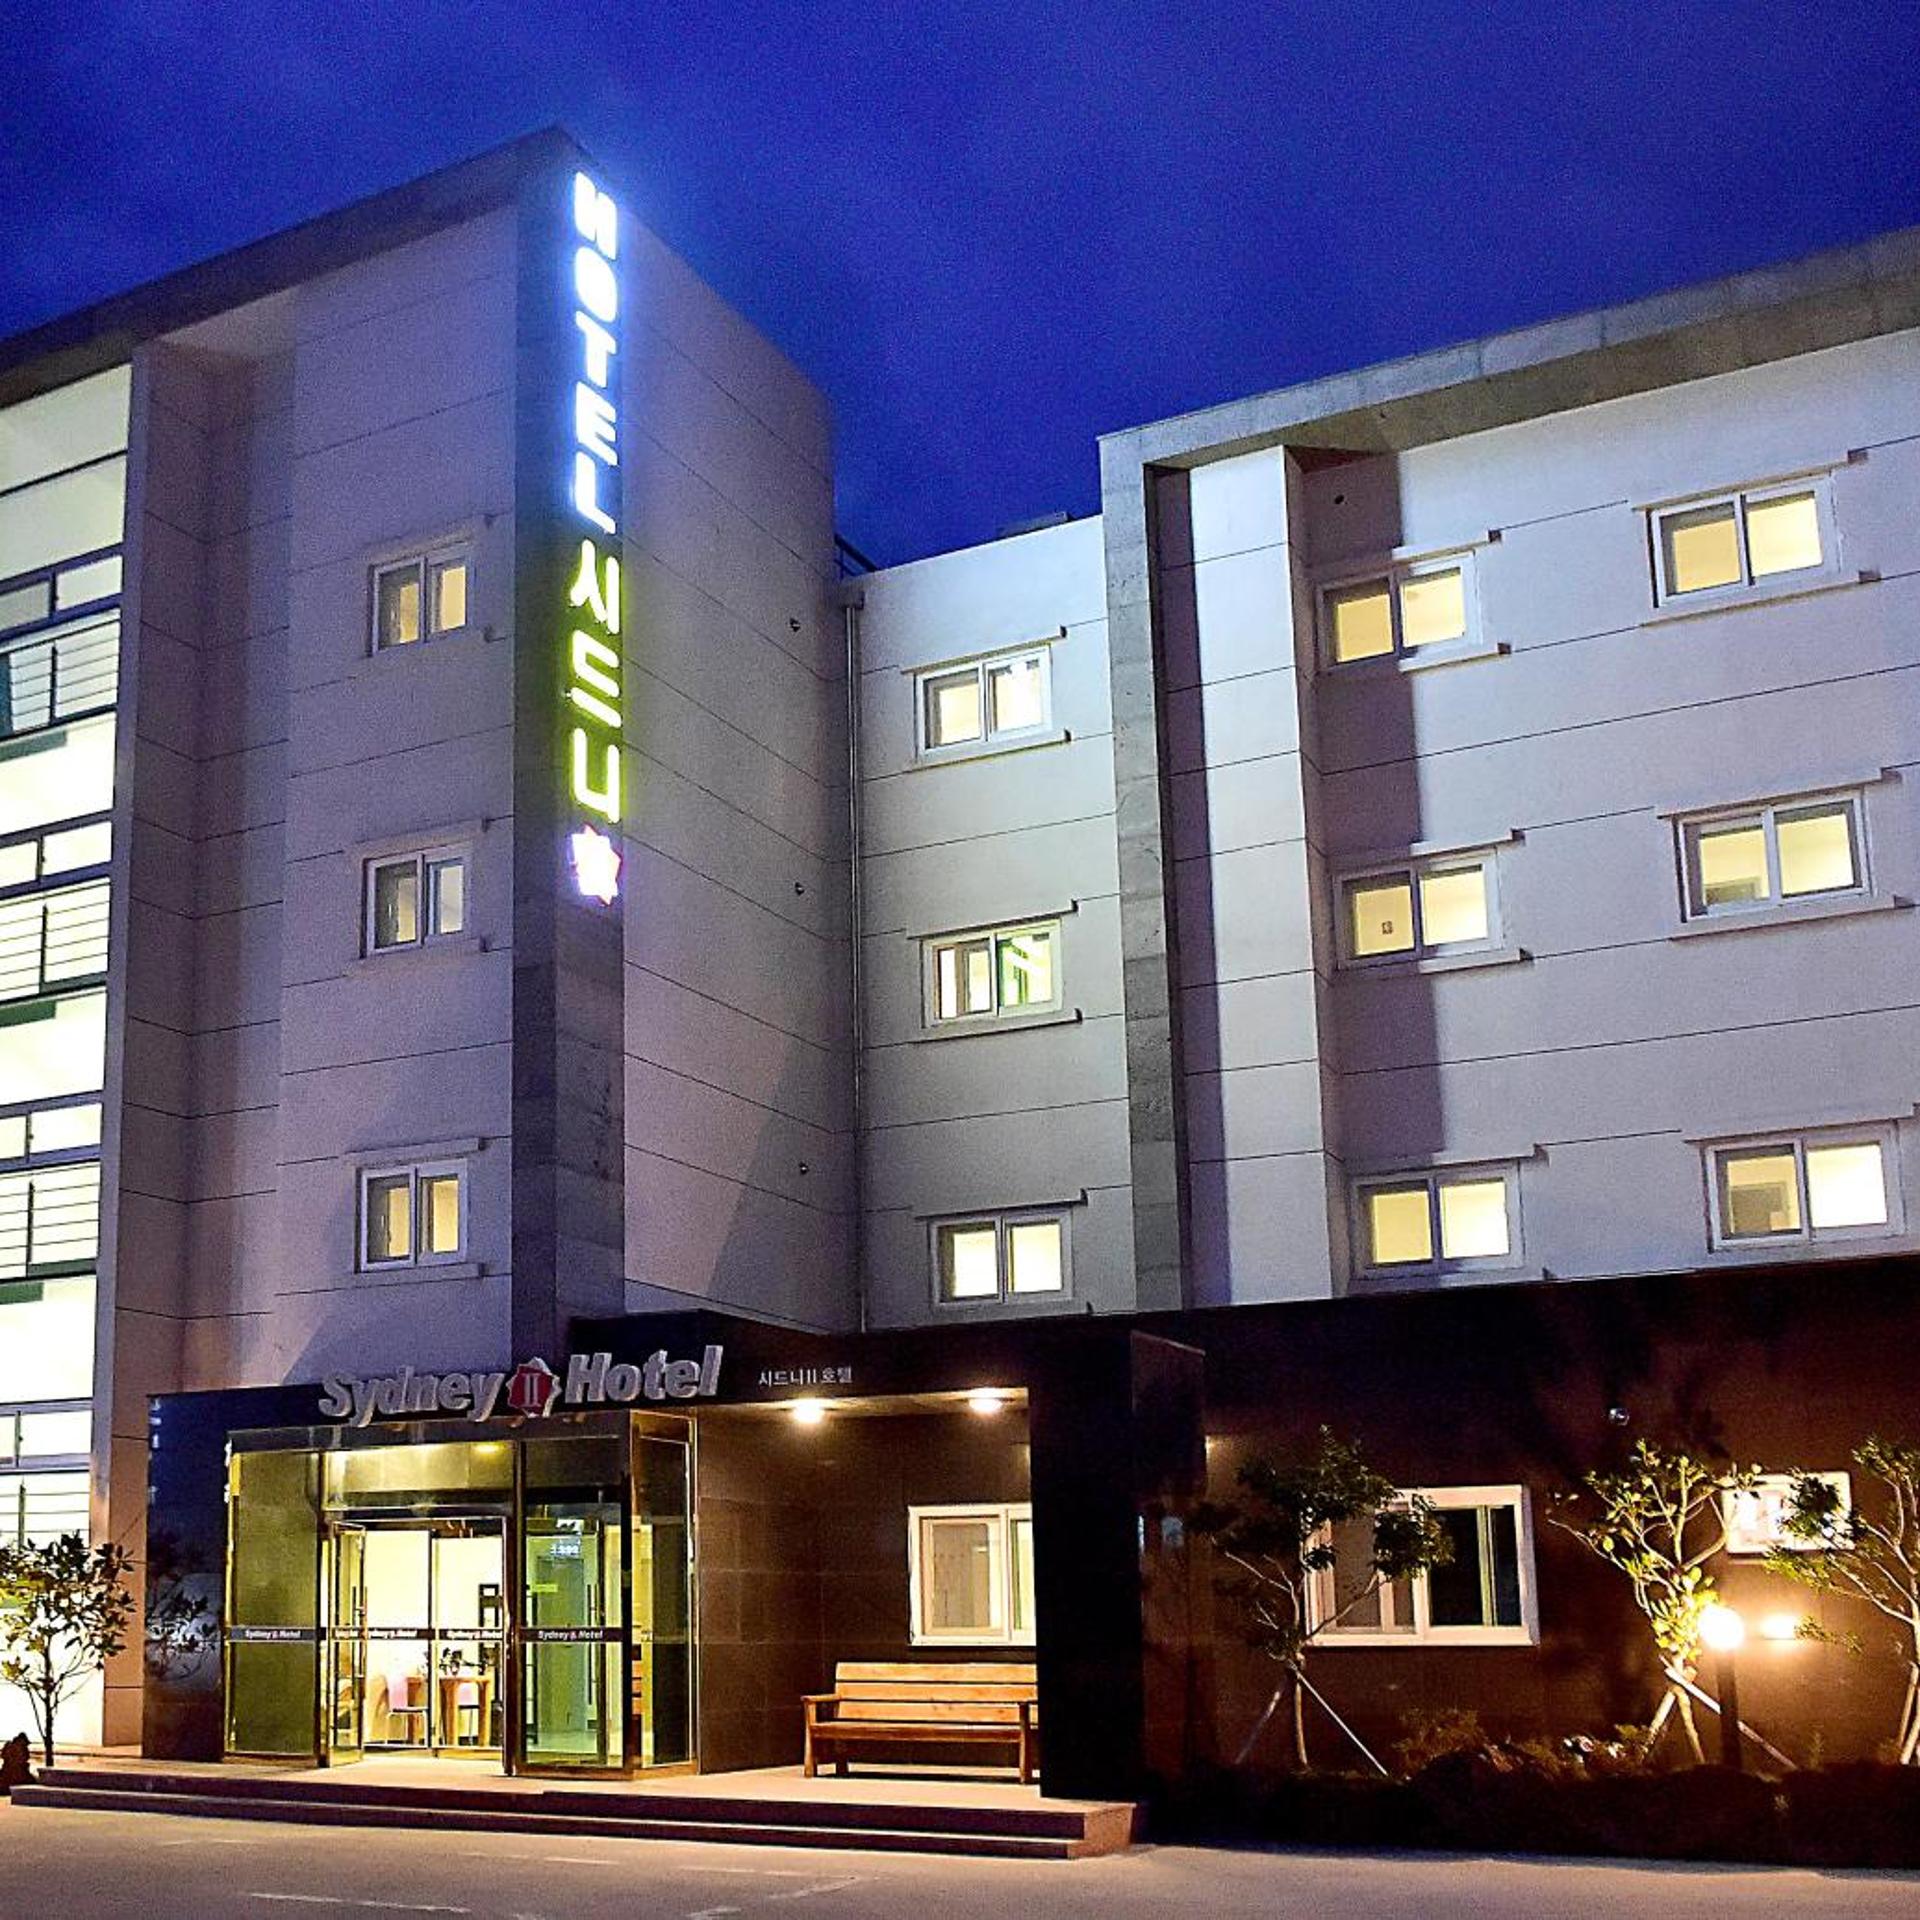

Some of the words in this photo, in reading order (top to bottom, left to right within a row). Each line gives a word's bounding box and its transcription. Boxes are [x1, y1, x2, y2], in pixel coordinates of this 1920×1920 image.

[574, 171, 618, 534] HOTEL
[569, 539, 622, 824] 시드니
[318, 1365, 505, 1428] Sydney
[565, 1345, 723, 1403] Hotel
[821, 1366, 852, 1384] 호텔
